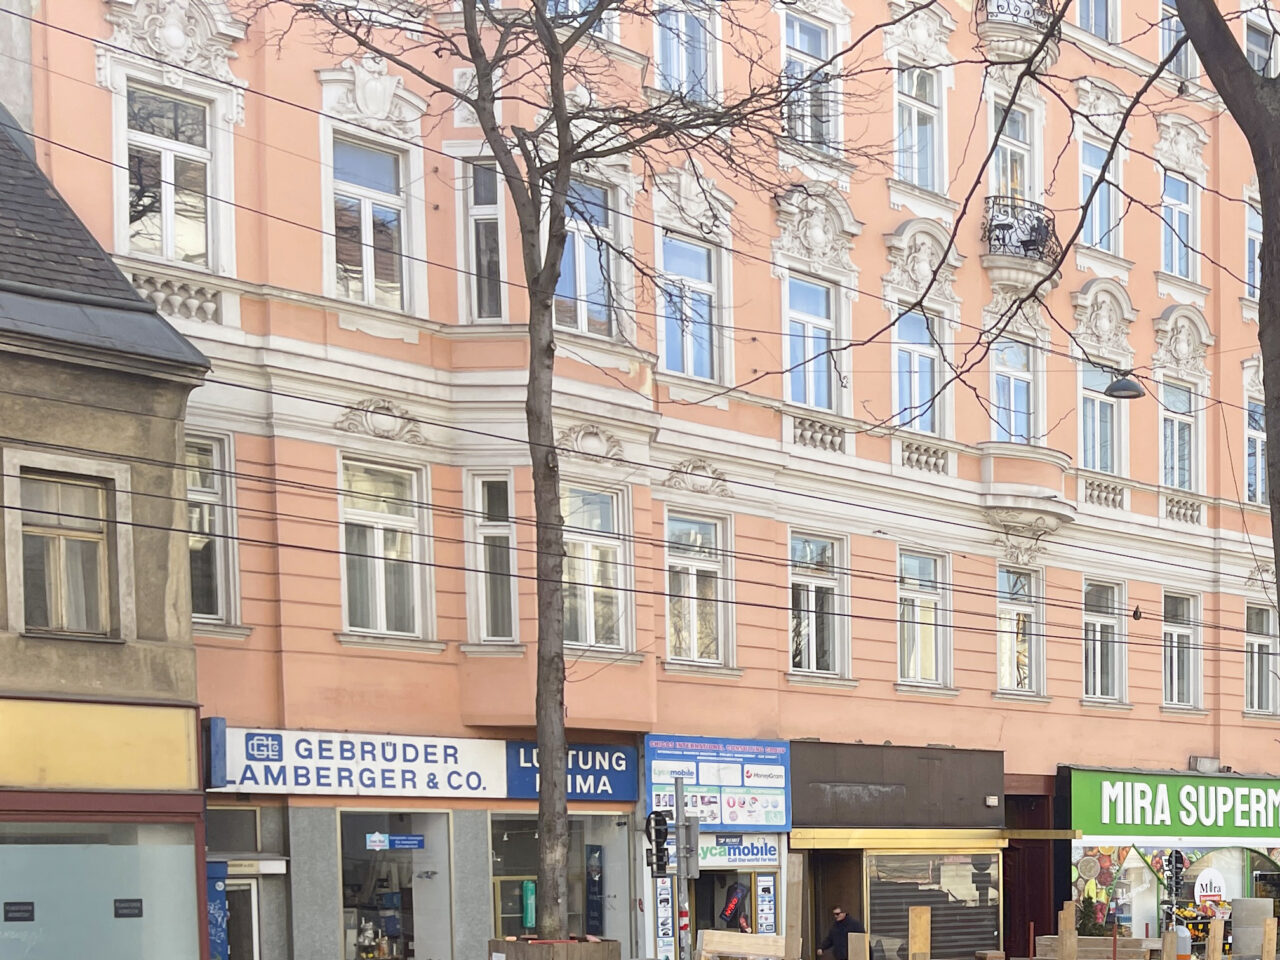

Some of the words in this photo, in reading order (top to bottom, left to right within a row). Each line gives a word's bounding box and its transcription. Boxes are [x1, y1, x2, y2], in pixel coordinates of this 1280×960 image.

[295, 738, 458, 764] GEBRÜDER
[519, 748, 626, 771] LTUNG
[426, 772, 439, 790] &
[447, 771, 487, 790] CO.
[536, 773, 613, 794] IMA
[1101, 781, 1171, 826] MIRA
[699, 843, 777, 860] ycamobile
